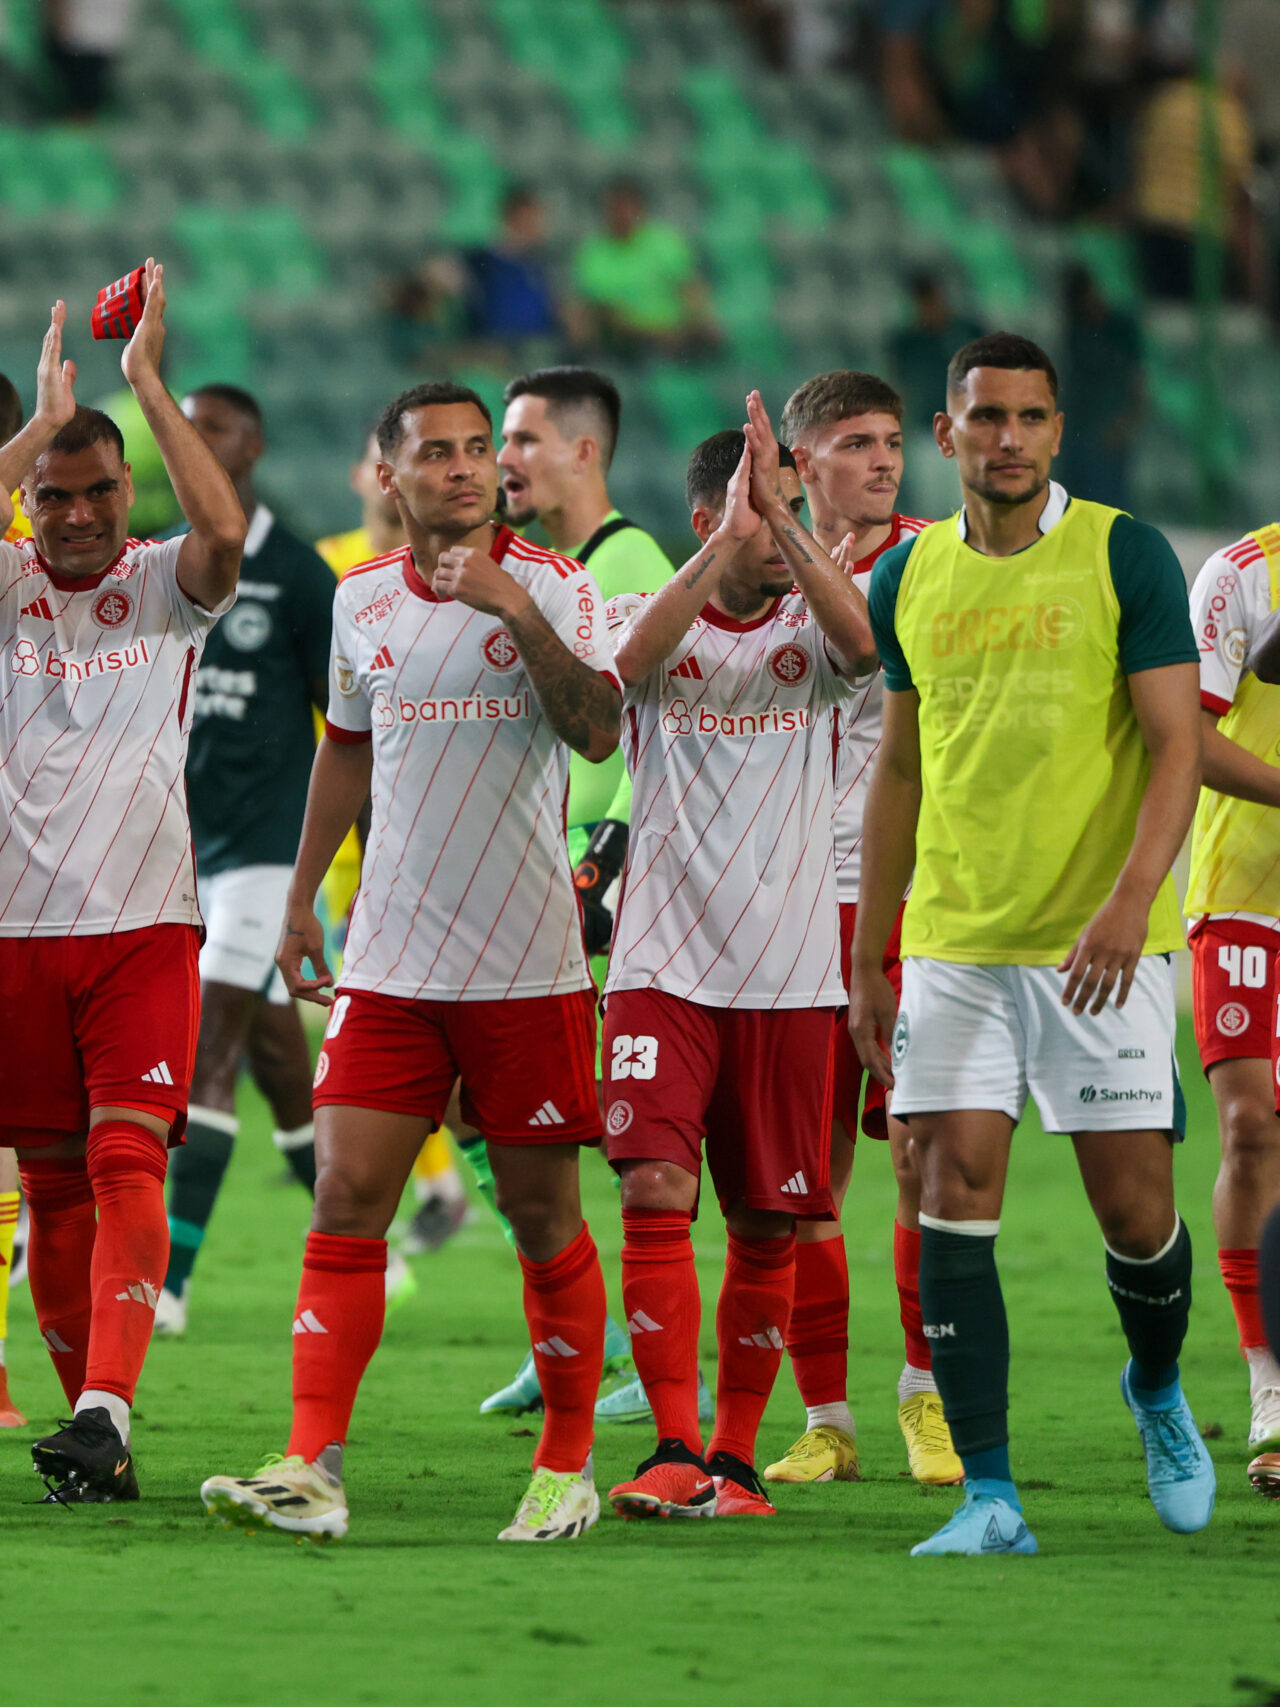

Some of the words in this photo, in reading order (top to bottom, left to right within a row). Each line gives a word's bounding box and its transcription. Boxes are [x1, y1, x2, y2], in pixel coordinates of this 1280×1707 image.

[354, 588, 401, 624] ESTRELA
[375, 601, 393, 621] BET
[576, 583, 595, 640] vero
[1199, 595, 1226, 652] vero
[931, 603, 1062, 658] GREEN
[399, 691, 530, 722] banrisul
[1218, 944, 1267, 988] 40
[611, 1034, 659, 1081] 23
[1118, 1048, 1145, 1059] GREEN
[1100, 1088, 1162, 1102] Sankhya
